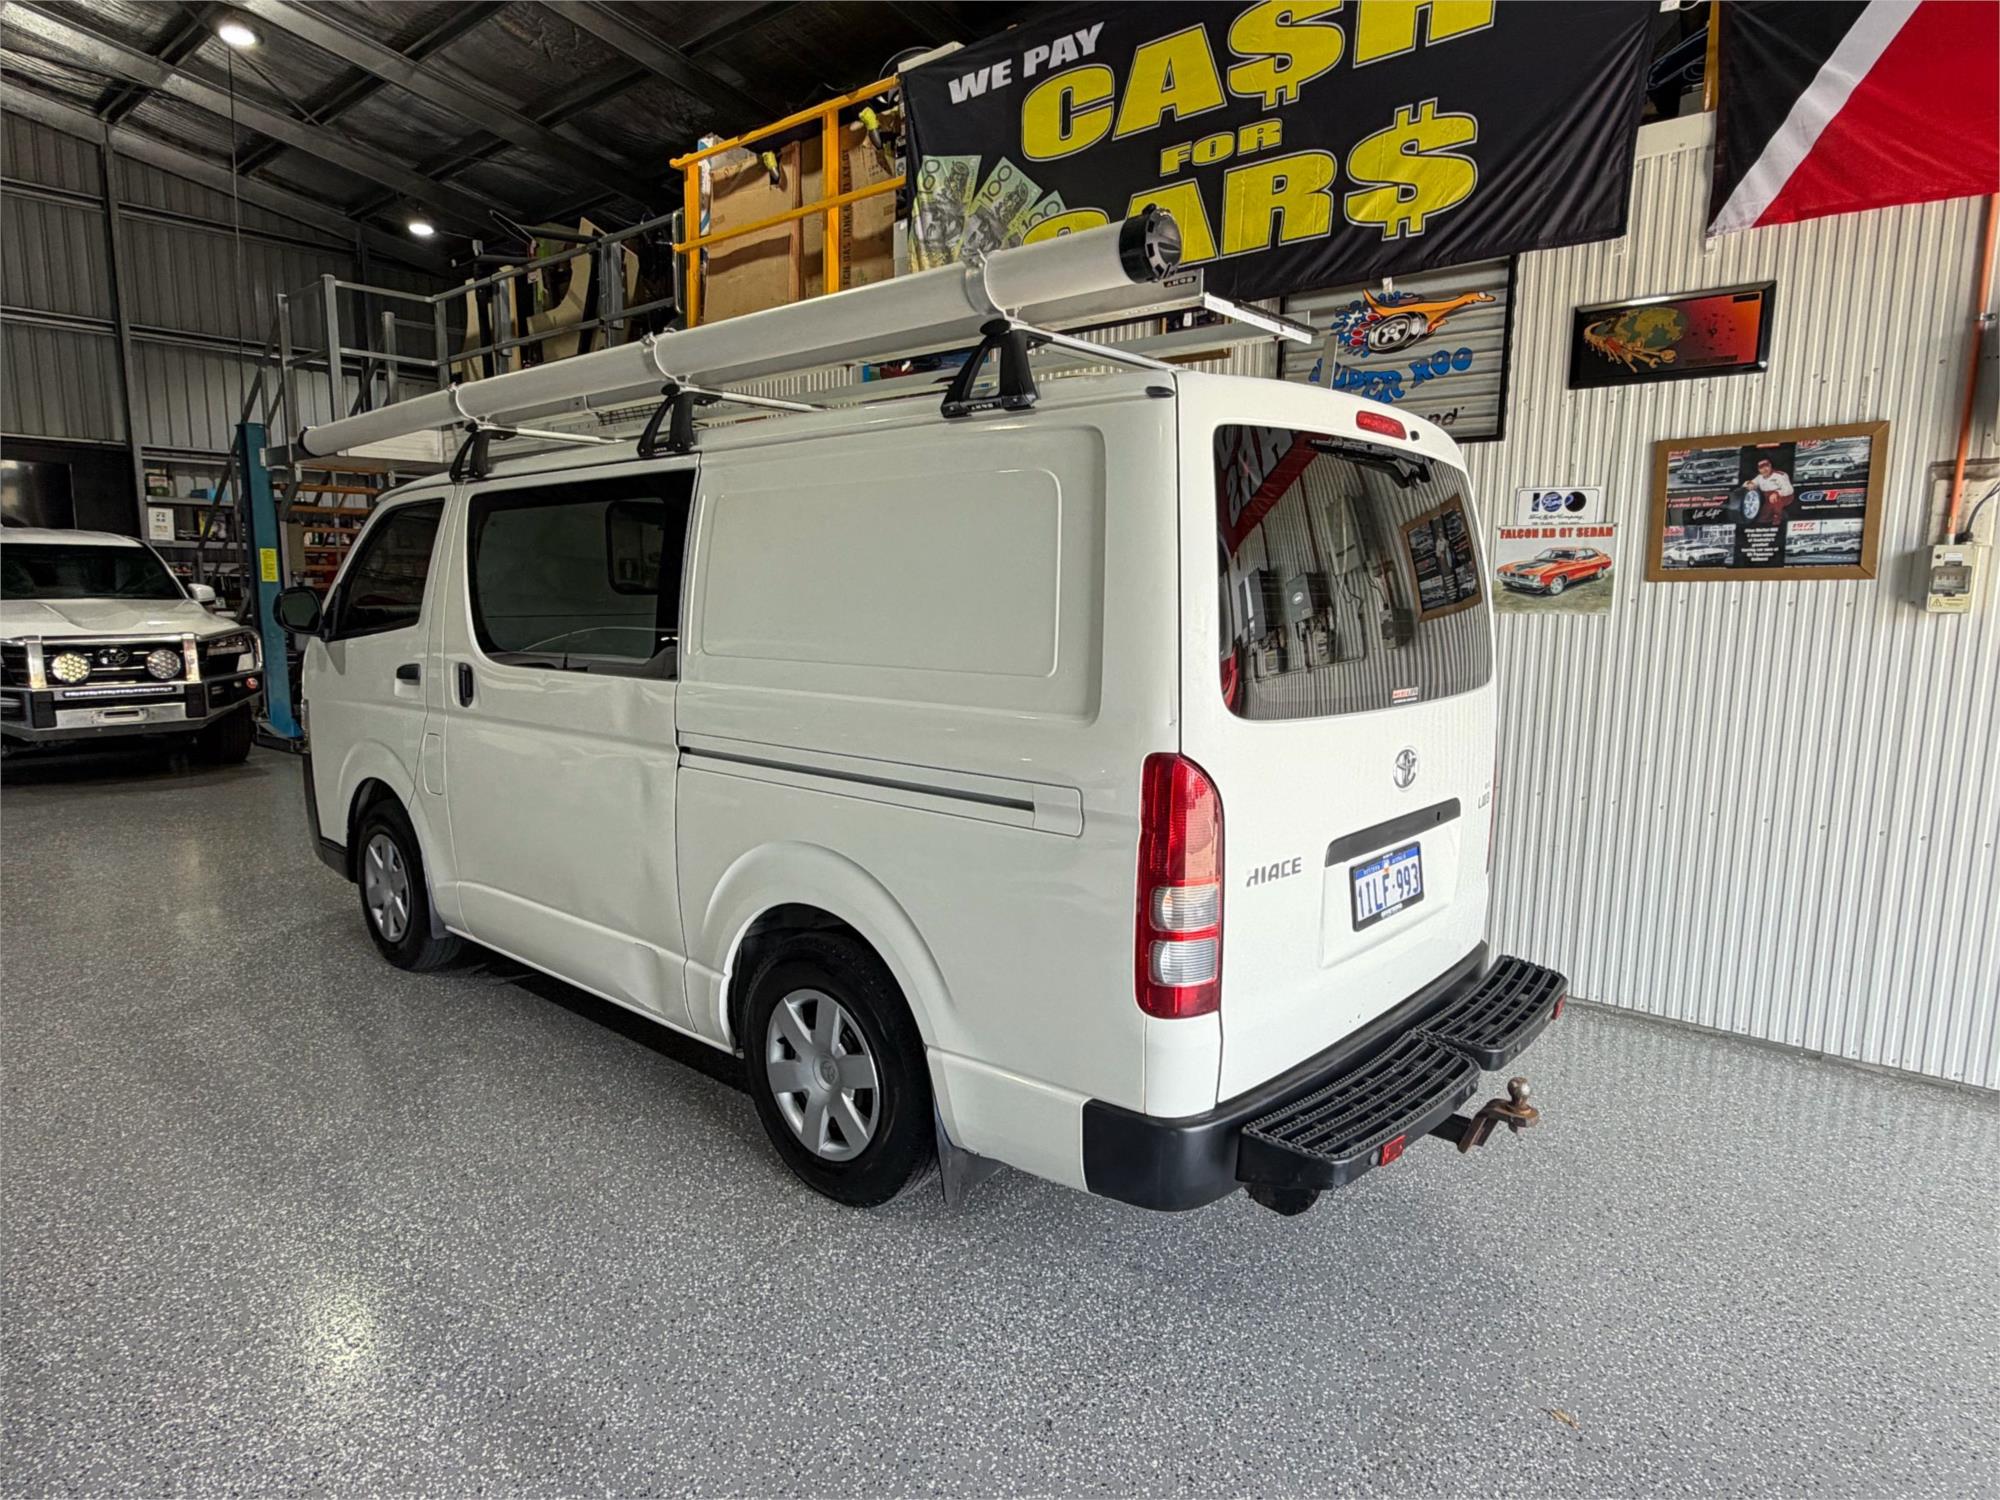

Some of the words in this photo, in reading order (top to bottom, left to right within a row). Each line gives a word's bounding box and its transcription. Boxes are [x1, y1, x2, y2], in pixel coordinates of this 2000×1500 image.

[948, 58, 1013, 105] WE
[1023, 21, 1105, 79] PAY
[1159, 118, 1282, 176] FOR
[1408, 347, 1474, 389] ROO
[1500, 528, 1539, 539] FALCON
[1576, 526, 1613, 538] SEDAN
[1246, 856, 1303, 888] HIACE
